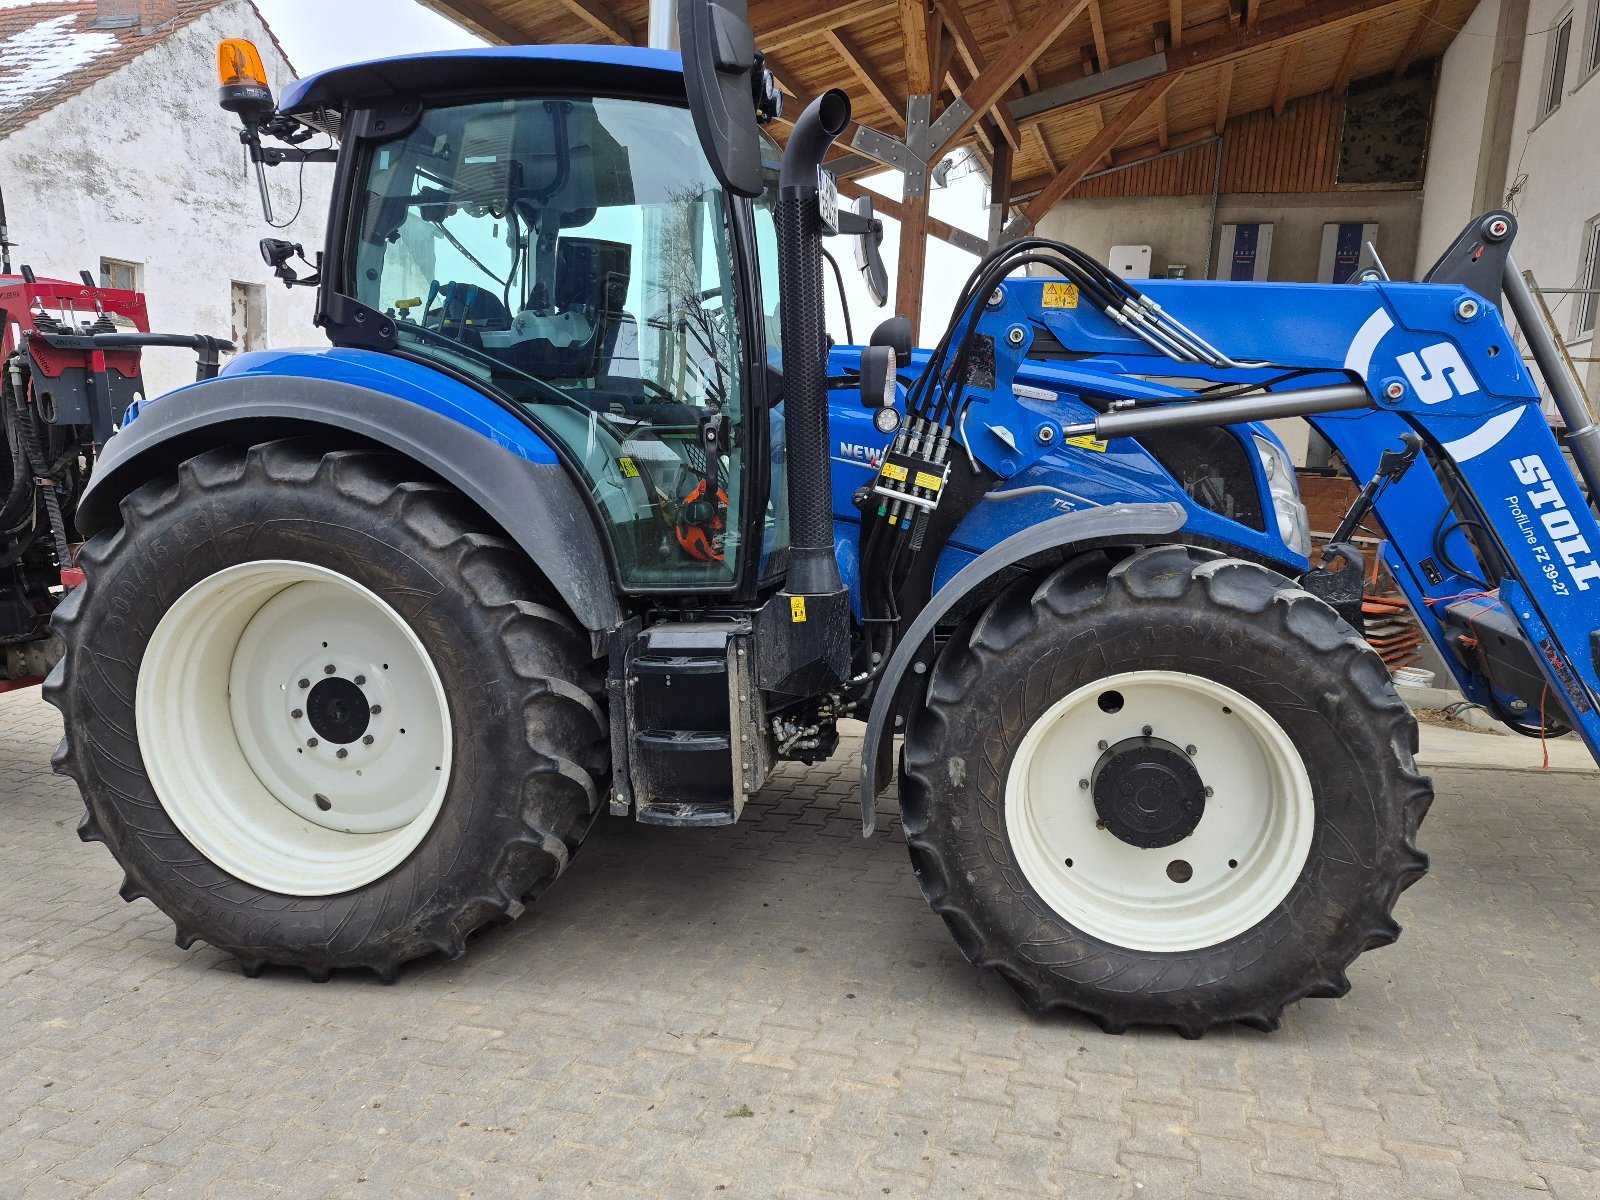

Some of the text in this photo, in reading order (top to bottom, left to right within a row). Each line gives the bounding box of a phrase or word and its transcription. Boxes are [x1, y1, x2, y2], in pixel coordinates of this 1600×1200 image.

[1395, 341, 1480, 405] S
[840, 441, 881, 462] NEW
[1504, 495, 1570, 597] ProfiLine FZ 39-27
[1509, 454, 1600, 592] STOLL
